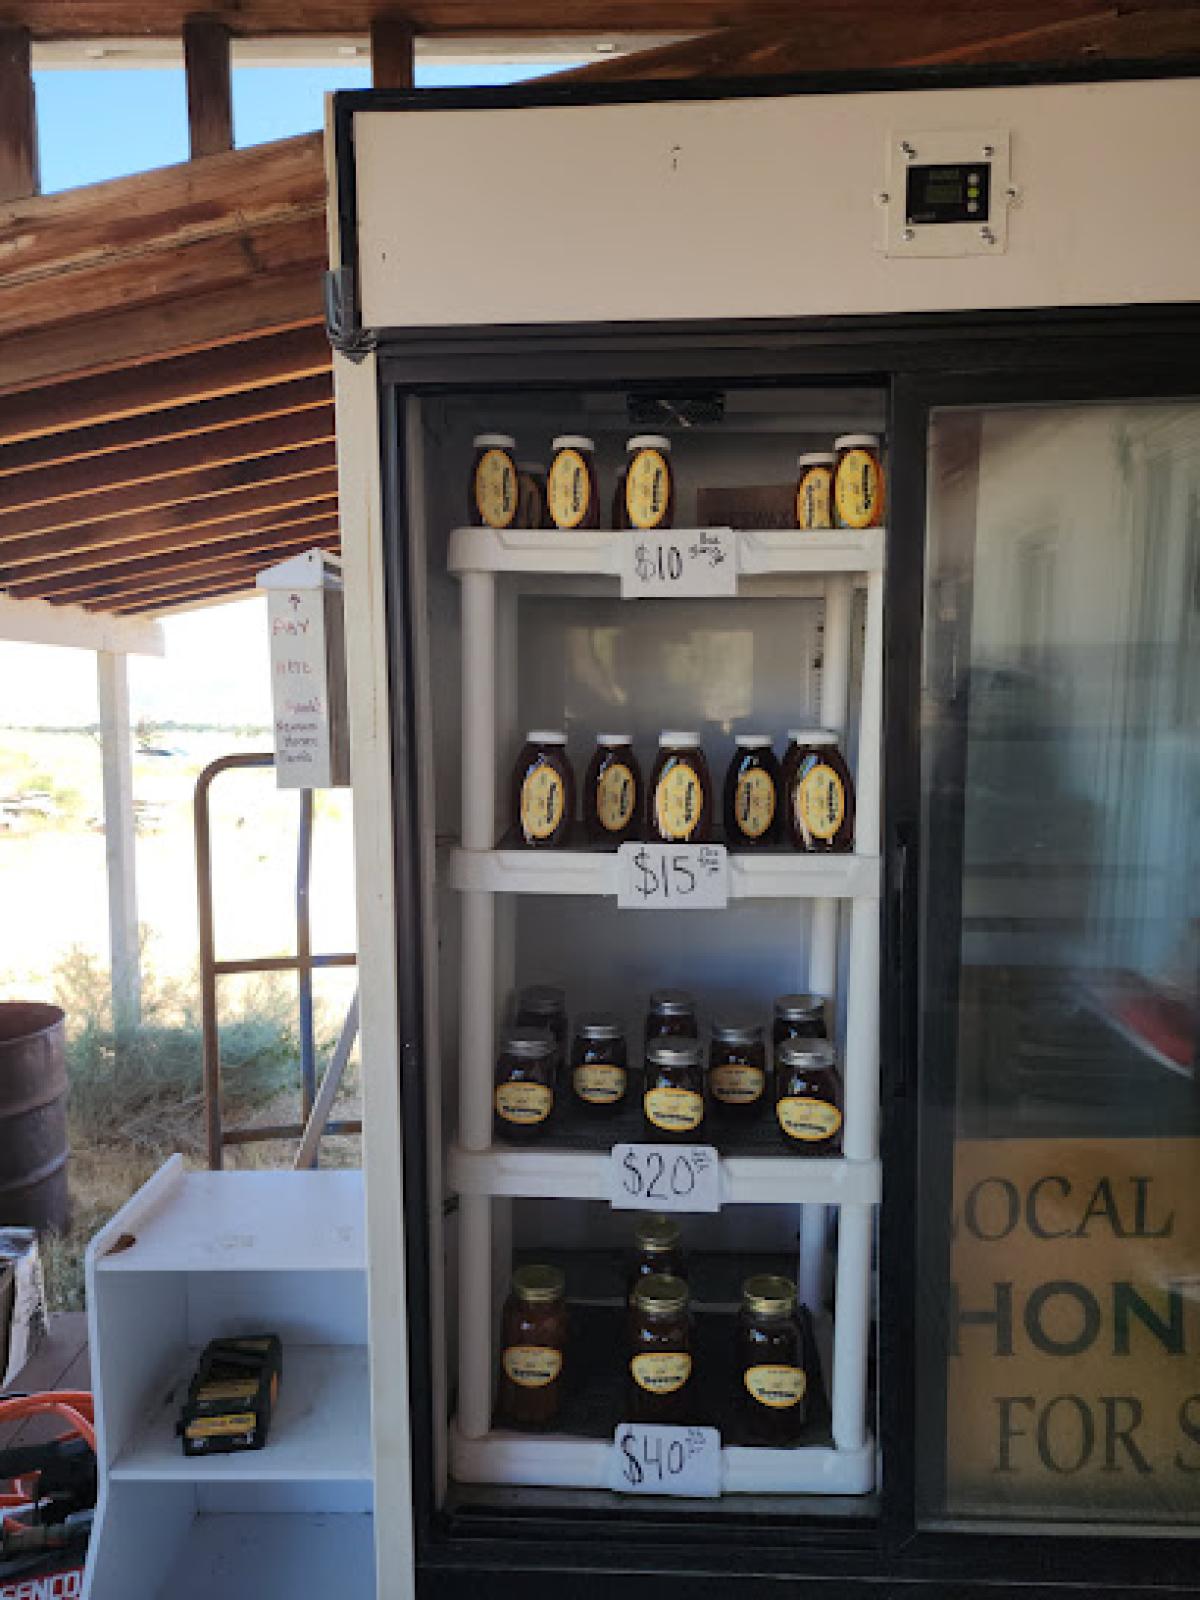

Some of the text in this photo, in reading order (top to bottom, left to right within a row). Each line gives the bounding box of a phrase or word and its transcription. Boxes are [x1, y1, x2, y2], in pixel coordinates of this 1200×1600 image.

[635, 544, 683, 582] $10
[633, 847, 695, 900] $15
[623, 1147, 695, 1200] $20
[952, 1176, 1175, 1241] OCAL
[950, 1281, 1200, 1357] HON
[621, 1426, 683, 1486] $40
[992, 1394, 1154, 1475] FOR
